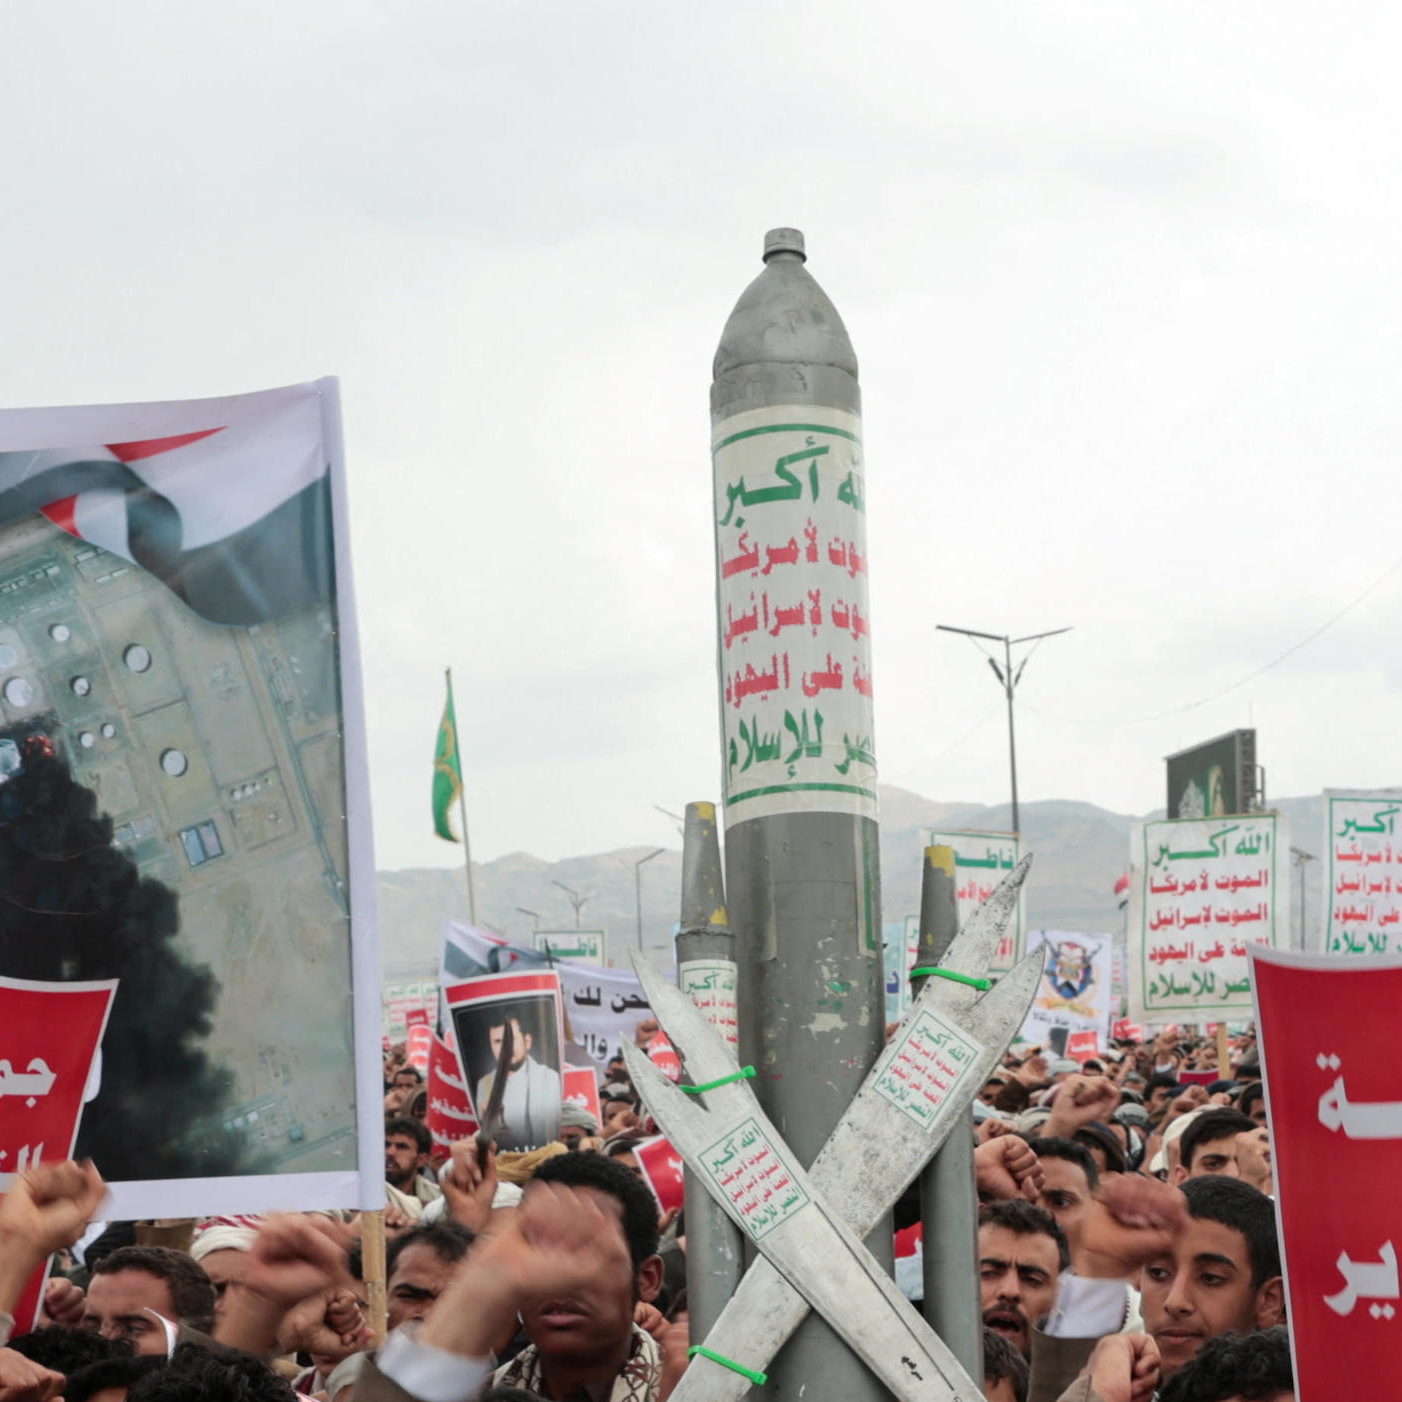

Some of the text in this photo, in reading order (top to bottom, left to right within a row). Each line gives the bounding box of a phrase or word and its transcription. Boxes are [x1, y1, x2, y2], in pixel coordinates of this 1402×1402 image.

[718, 435, 831, 529] أكبر
[1152, 822, 1271, 871] الله أكبر
[1215, 868, 1269, 894] الموت
[1214, 902, 1268, 927] الموت
